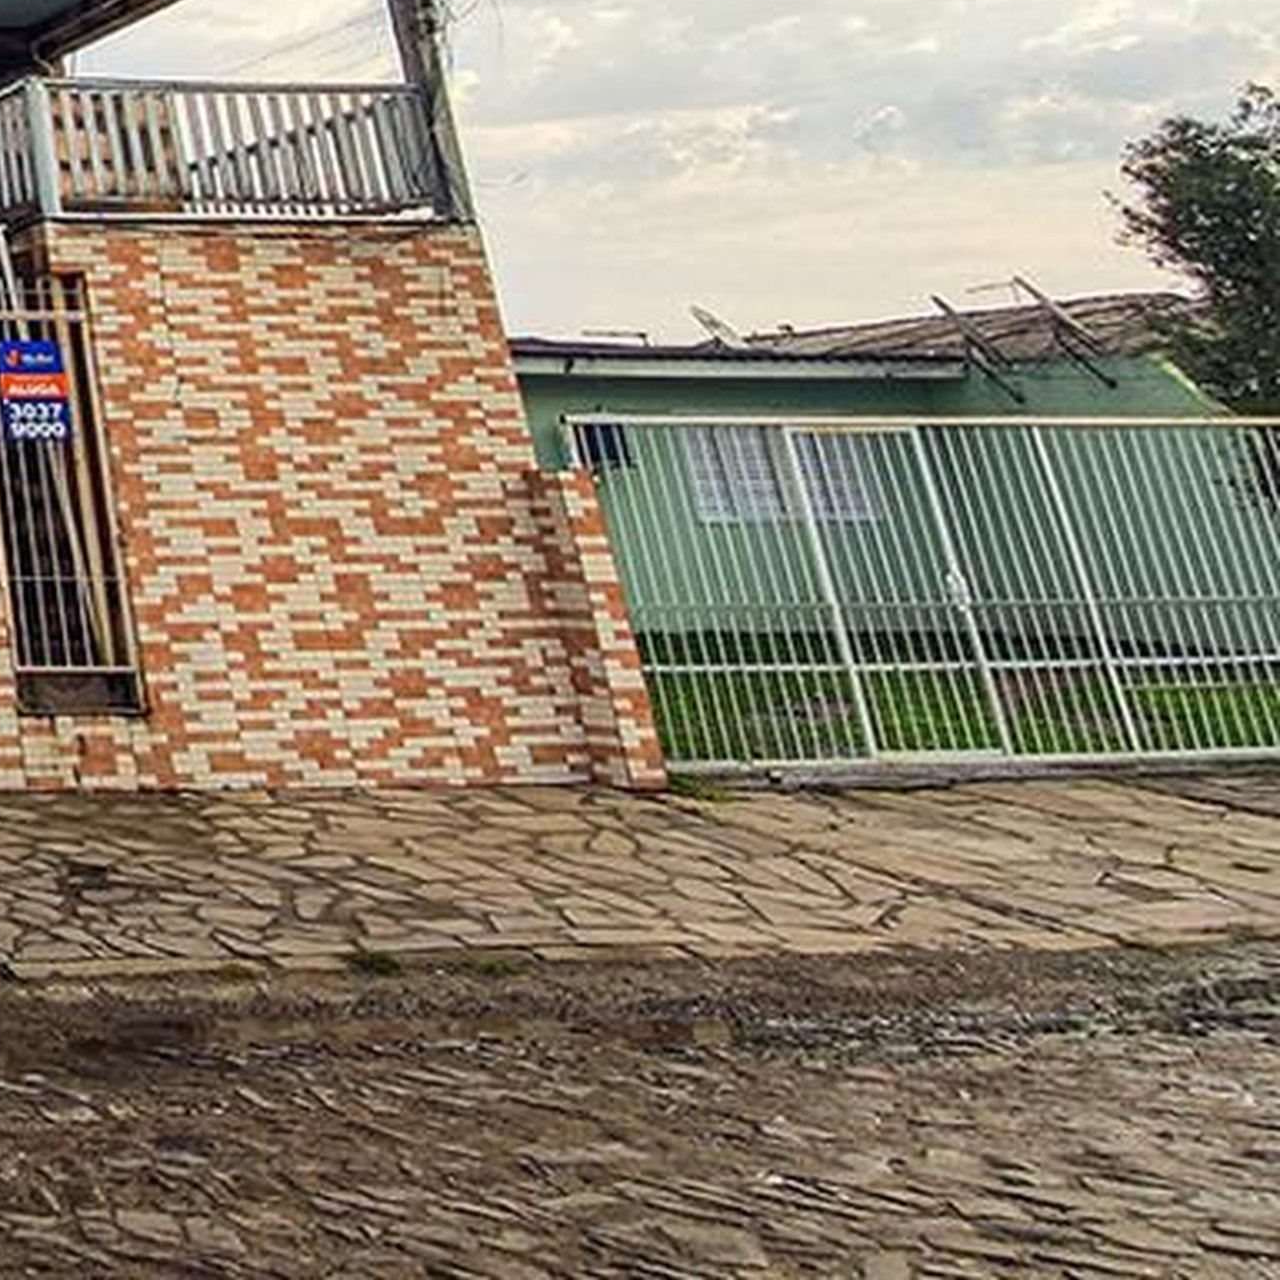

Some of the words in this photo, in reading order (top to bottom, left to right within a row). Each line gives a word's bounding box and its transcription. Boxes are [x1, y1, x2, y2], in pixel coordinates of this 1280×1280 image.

[8, 382, 61, 396] ALUGA
[8, 402, 63, 419] 3037
[10, 422, 66, 439] 9000
